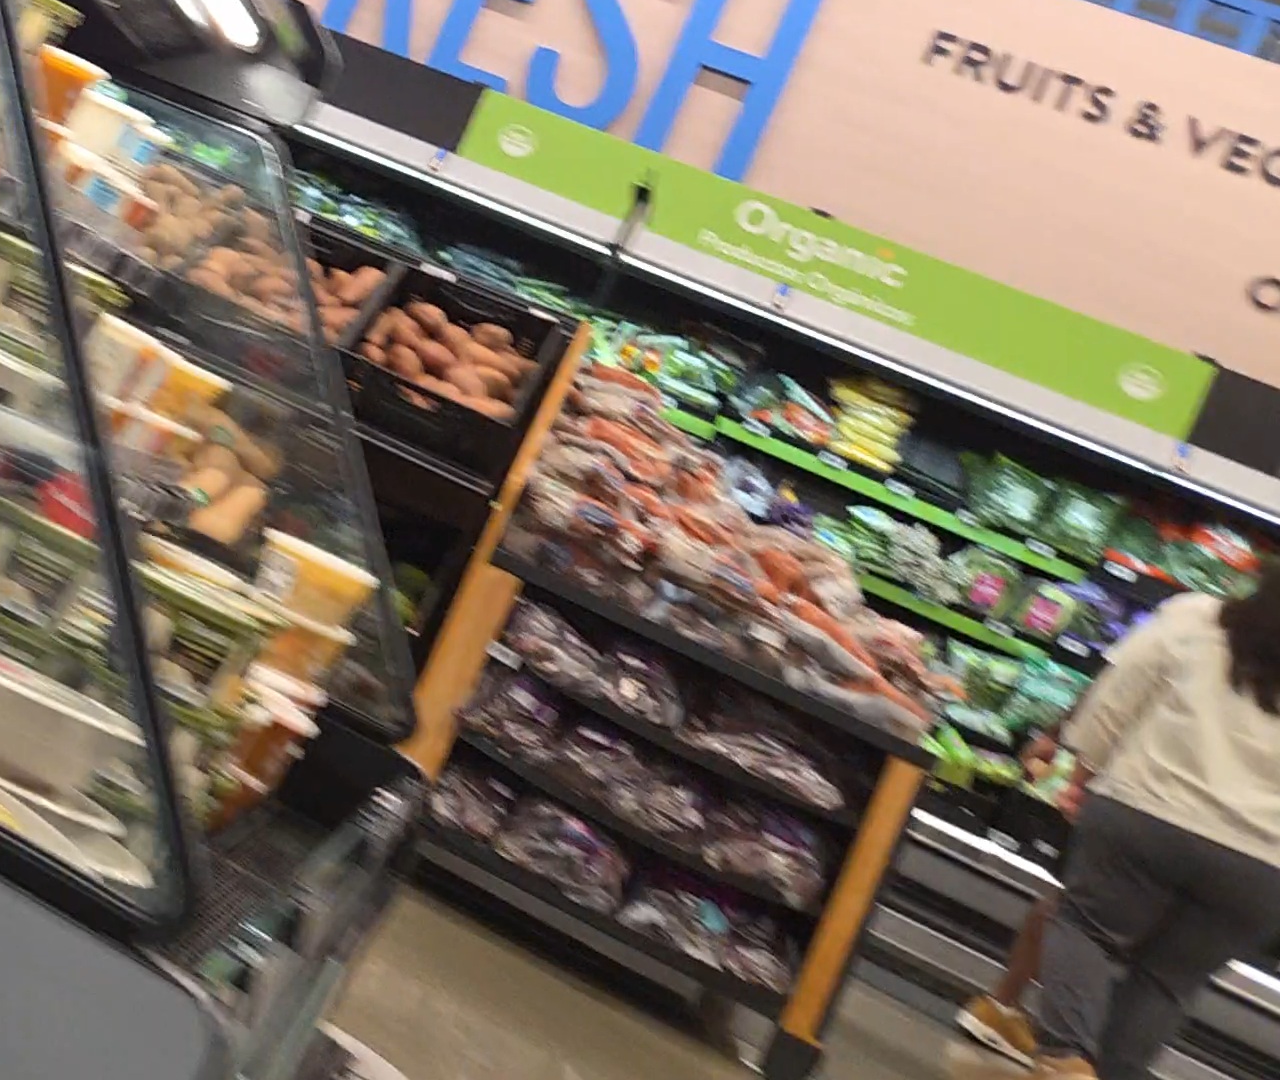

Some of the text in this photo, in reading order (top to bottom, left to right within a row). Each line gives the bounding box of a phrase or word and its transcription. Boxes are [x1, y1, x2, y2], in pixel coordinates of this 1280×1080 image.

[922, 29, 1116, 124] FRUITS
[1127, 100, 1165, 143] &
[734, 200, 908, 288] Organic
